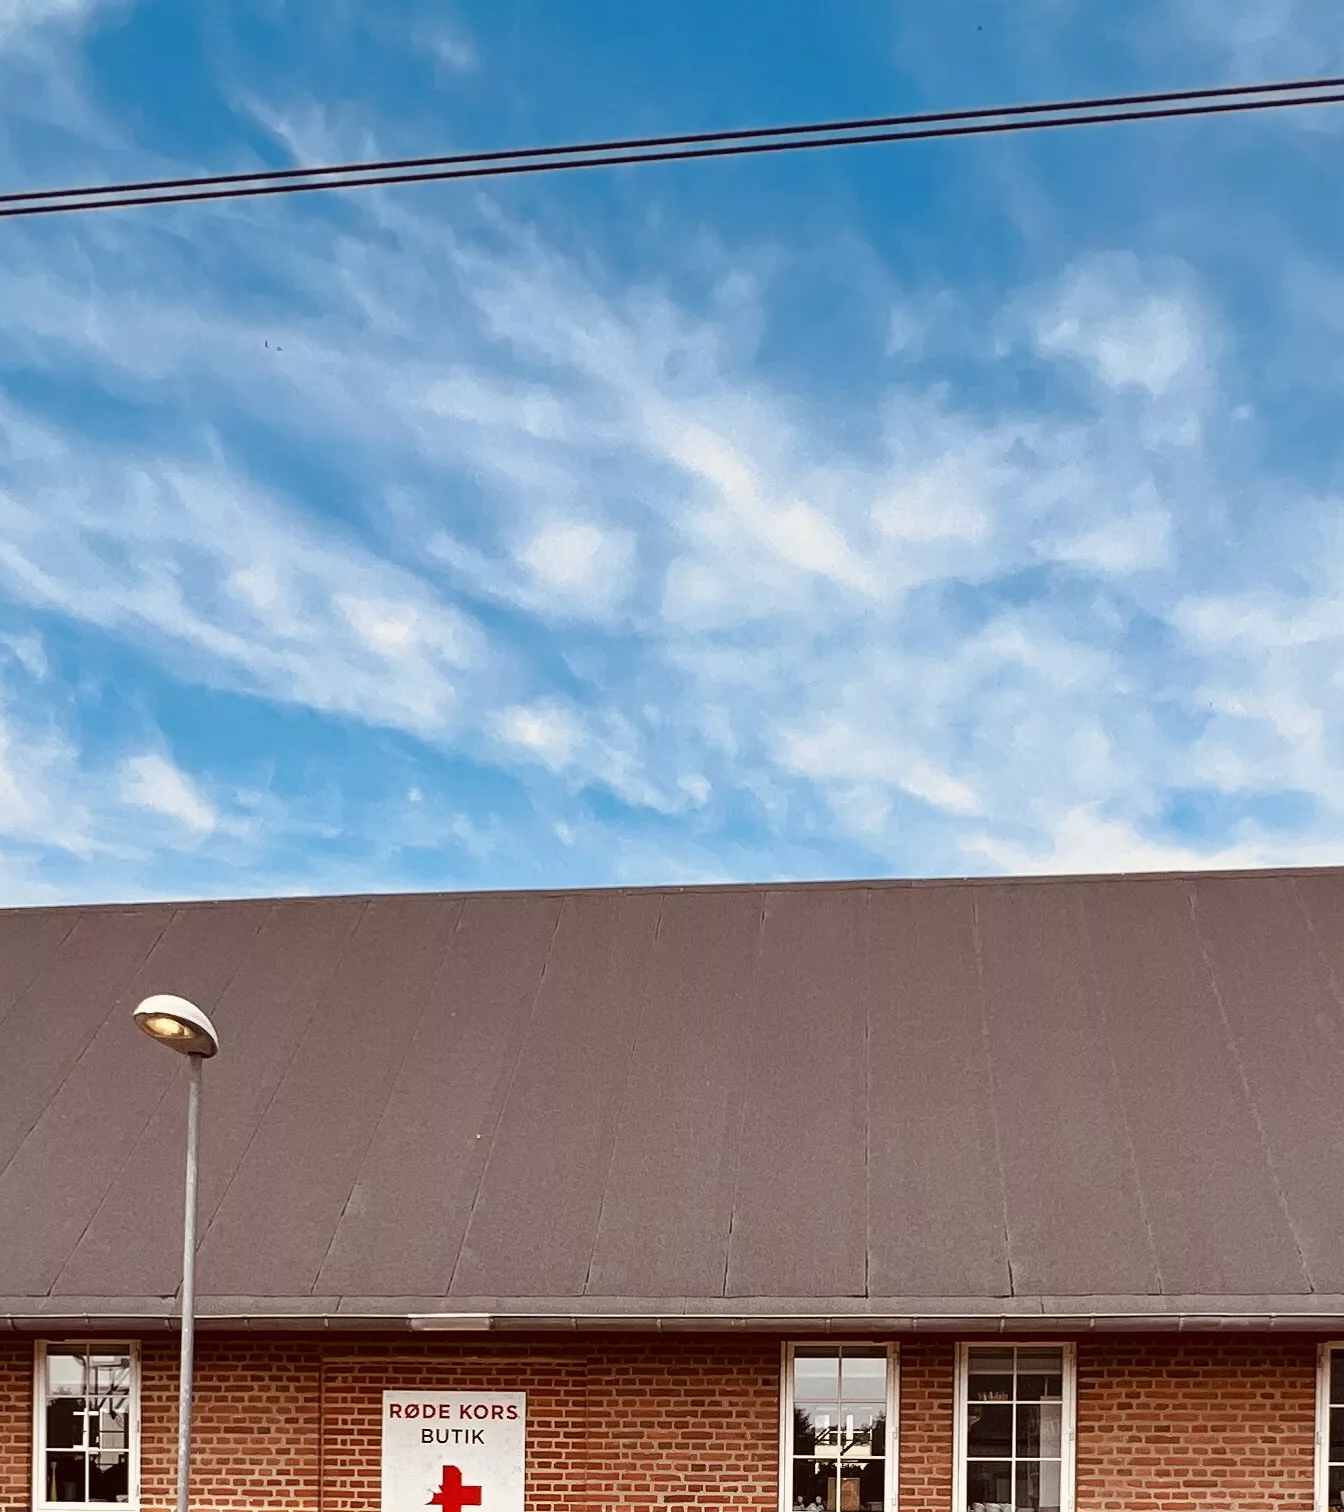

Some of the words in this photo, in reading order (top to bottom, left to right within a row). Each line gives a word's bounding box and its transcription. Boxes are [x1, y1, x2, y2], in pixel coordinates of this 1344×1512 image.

[389, 1404, 451, 1420] RØDE
[460, 1404, 519, 1420] KORS
[421, 1428, 485, 1444] BUTIK
